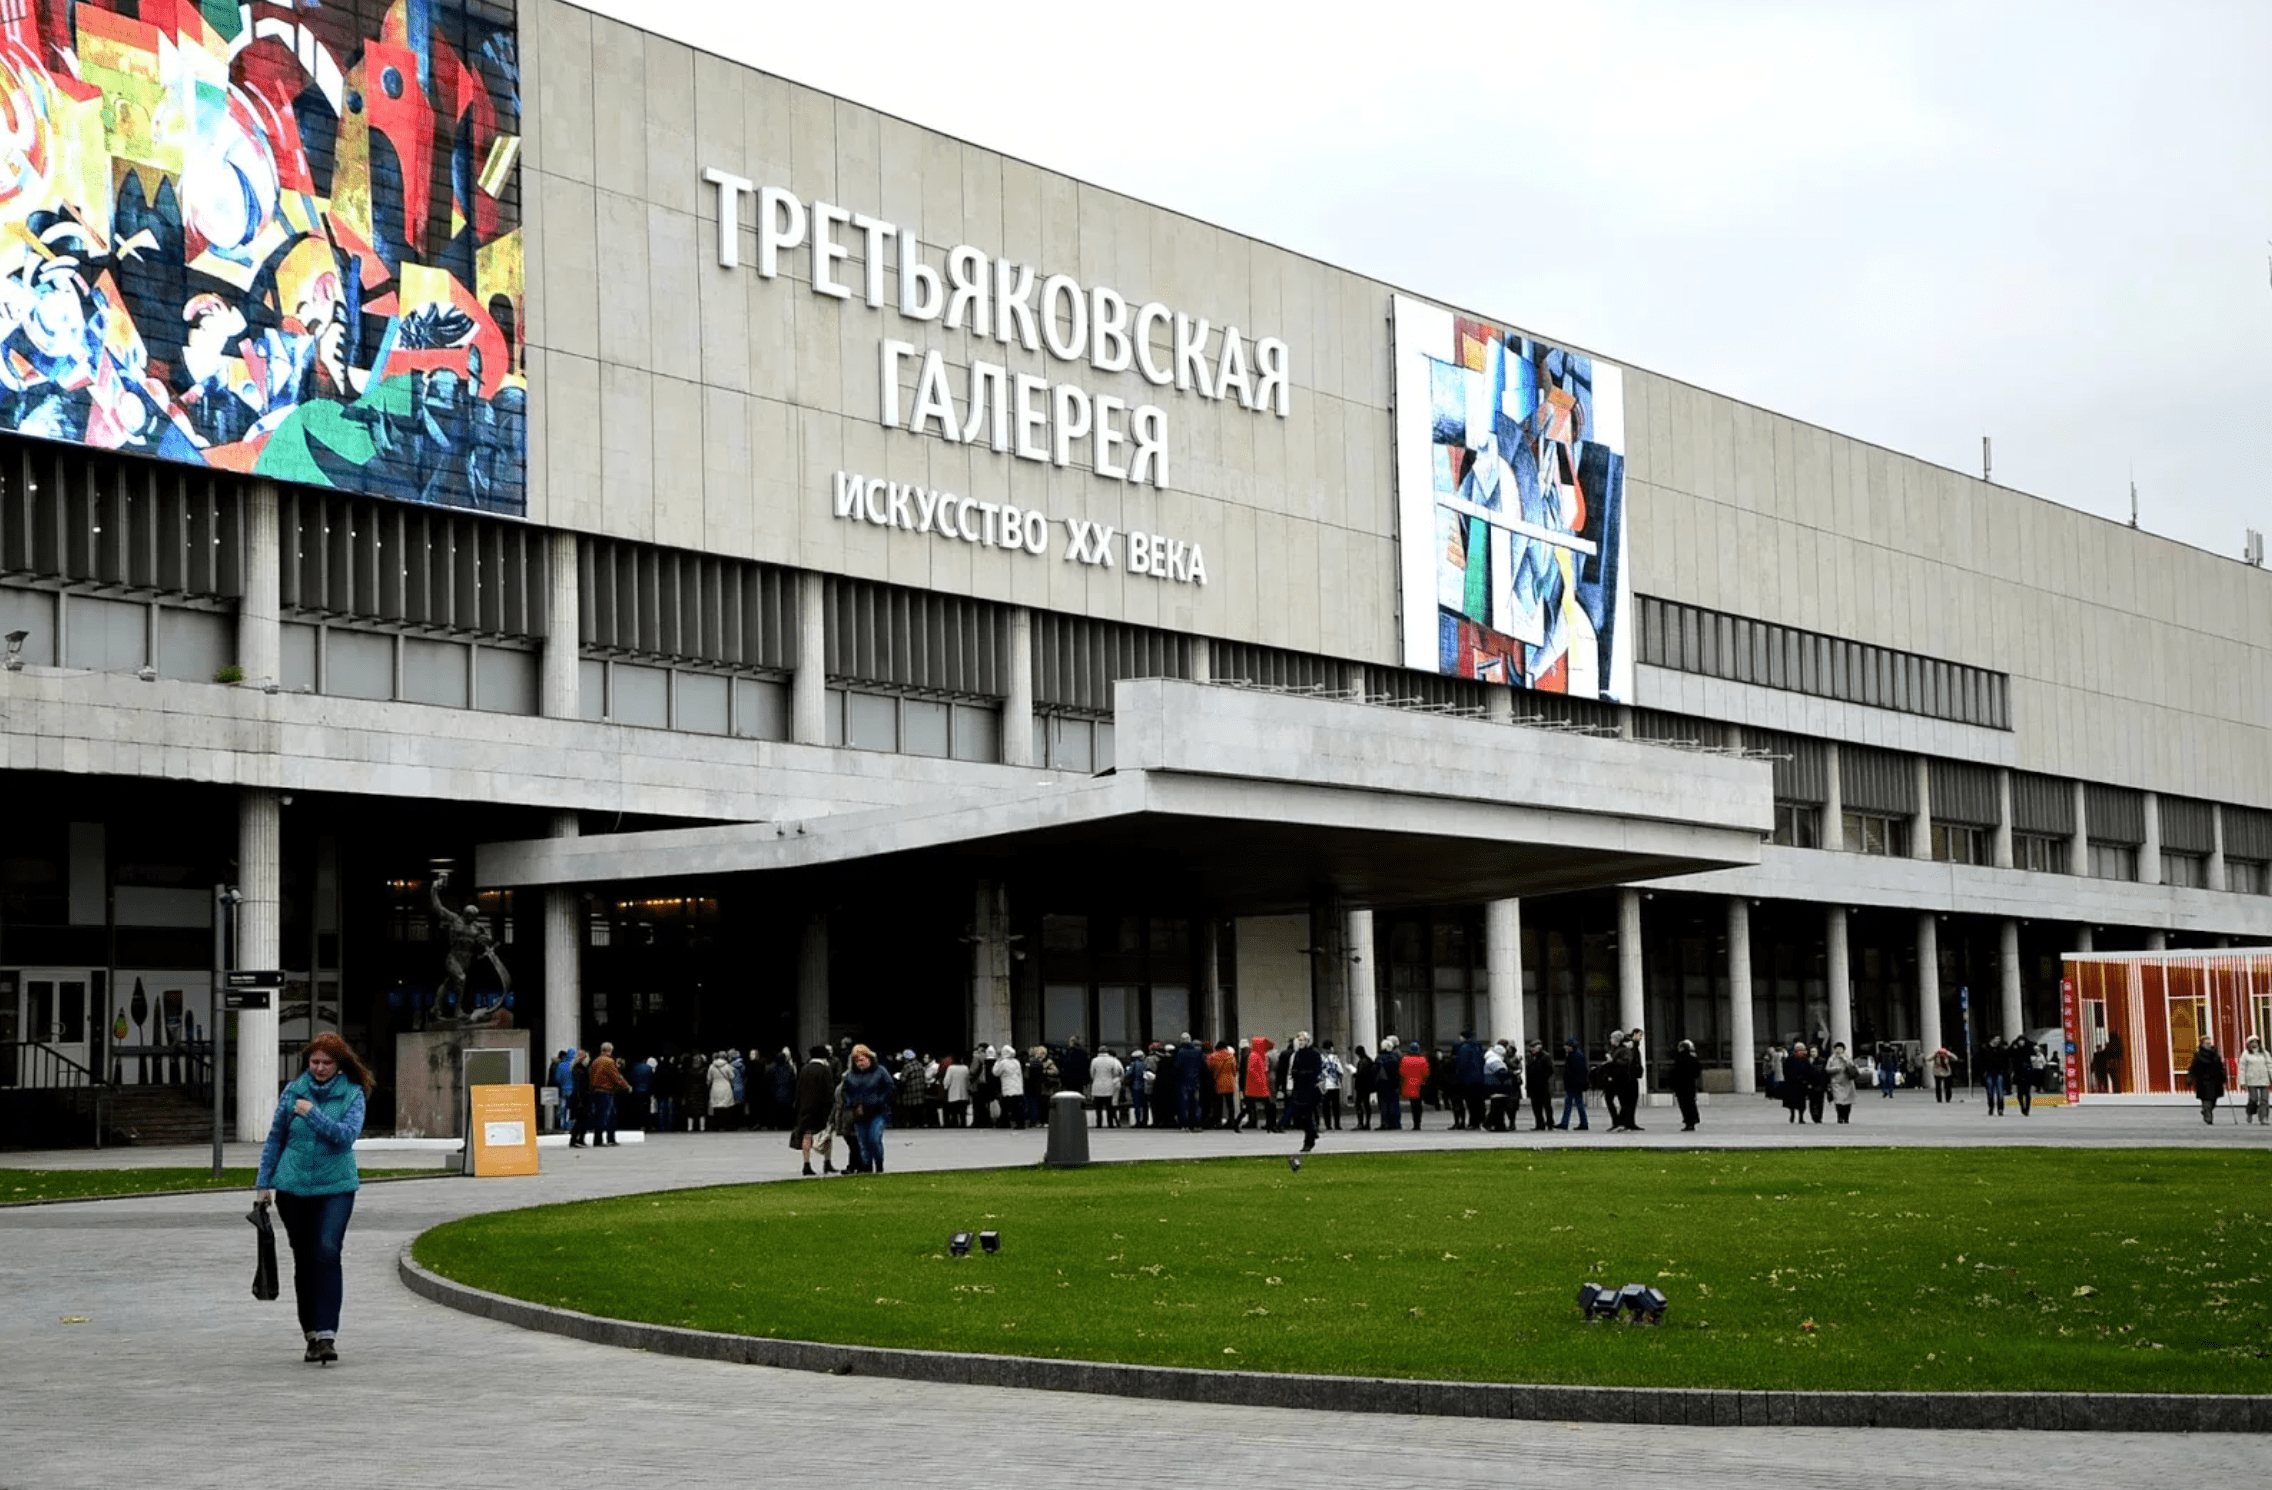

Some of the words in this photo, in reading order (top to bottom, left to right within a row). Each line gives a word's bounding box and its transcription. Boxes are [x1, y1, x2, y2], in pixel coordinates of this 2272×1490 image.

[702, 166, 1290, 418] ТРЕТЬЯКОВСКАЯ
[878, 338, 1170, 489] ГАЛЕРЕЯ
[833, 470, 1049, 556] ИСКУССТВО
[1126, 531, 1209, 585] ВЕКА
